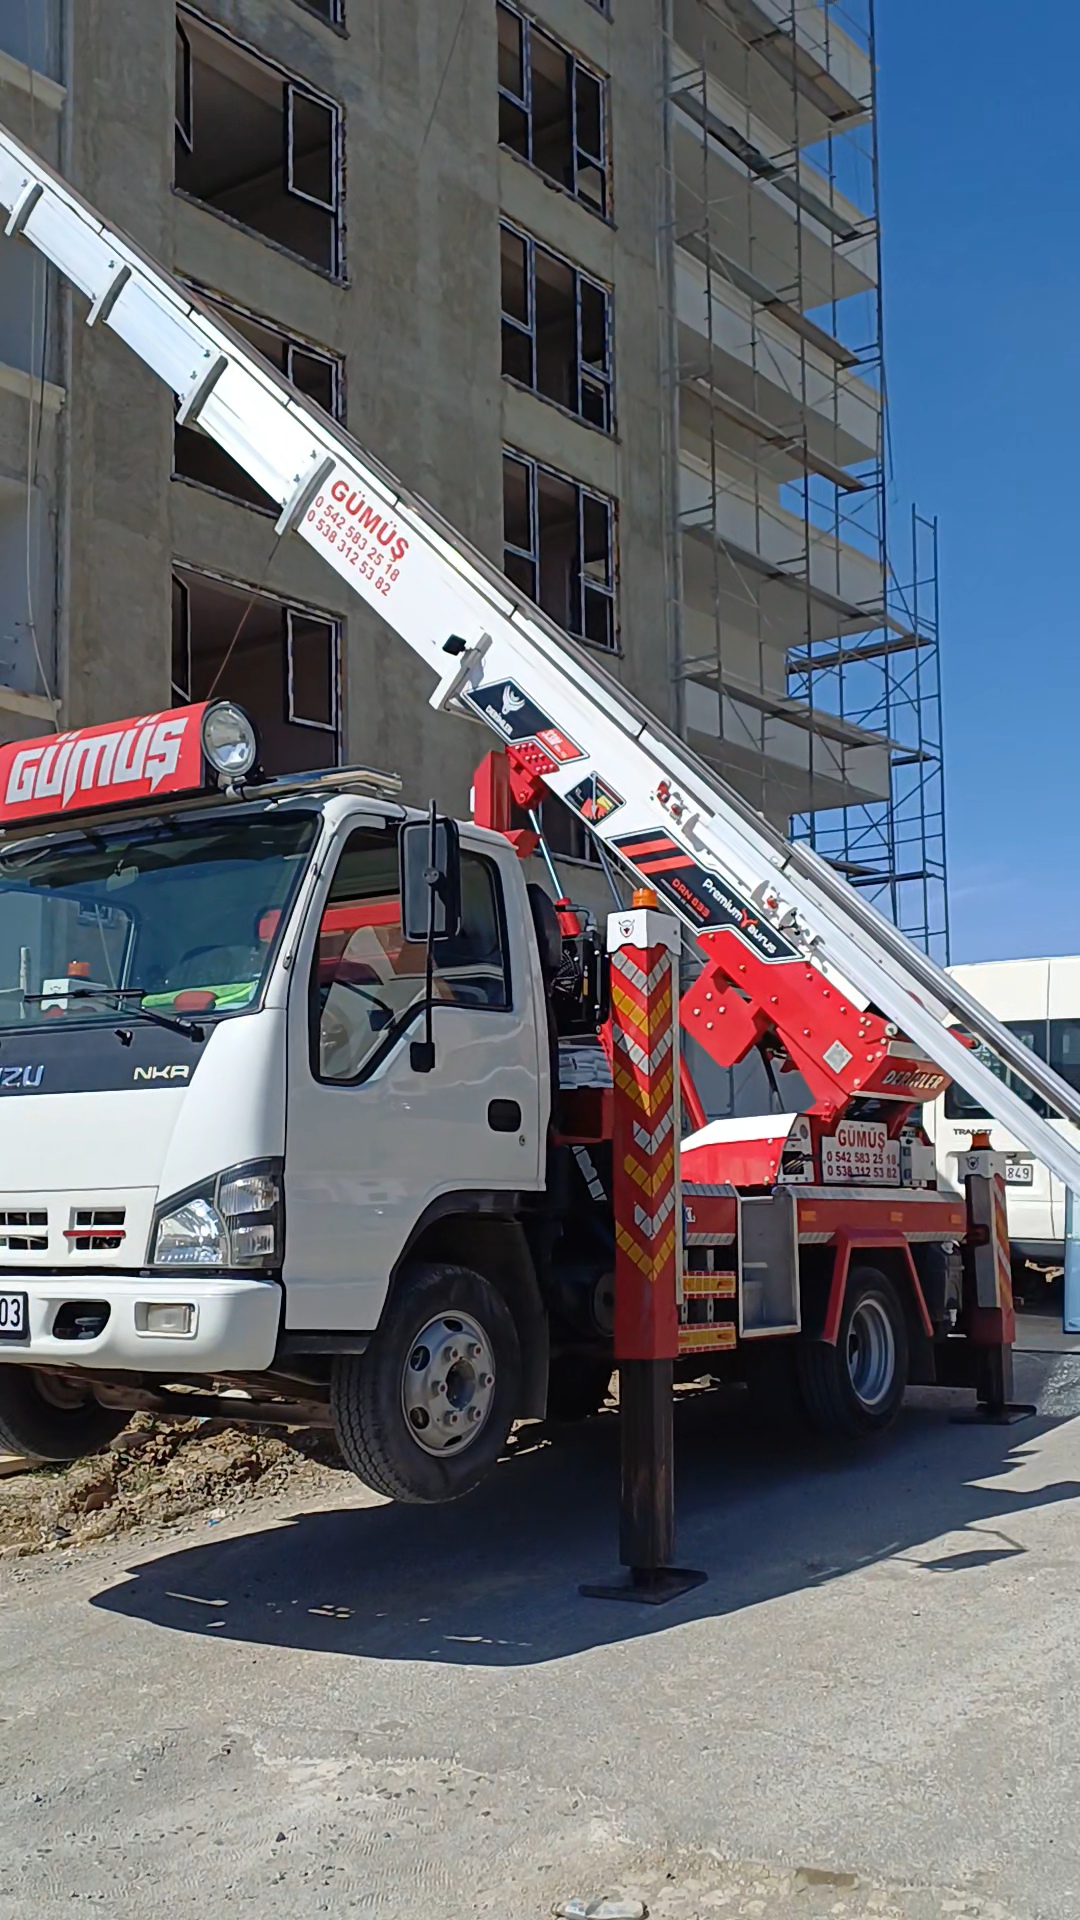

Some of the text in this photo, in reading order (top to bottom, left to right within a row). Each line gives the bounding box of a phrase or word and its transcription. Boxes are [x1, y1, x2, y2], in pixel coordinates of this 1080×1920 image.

[331, 480, 409, 562] GÜMÜŞ
[315, 495, 400, 582] 0 542 583 25 18
[307, 509, 391, 597] 0 538 312 53 82
[5, 712, 189, 808] GÜMÜŞ
[671, 878, 693, 901] DRN
[702, 878, 742, 922] Premium
[0, 1065, 44, 1087] ZU
[134, 1065, 190, 1080] NKR
[838, 1125, 885, 1153] GÜMÜŞ
[826, 1151, 897, 1165] 0 542 583 25 18
[827, 1165, 834, 1176] 0
[836, 1165, 852, 1177] 538
[873, 1167, 885, 1178] 53
[887, 1168, 898, 1178] 82
[1007, 1167, 1030, 1180] 849
[0, 1298, 20, 1327] 03
